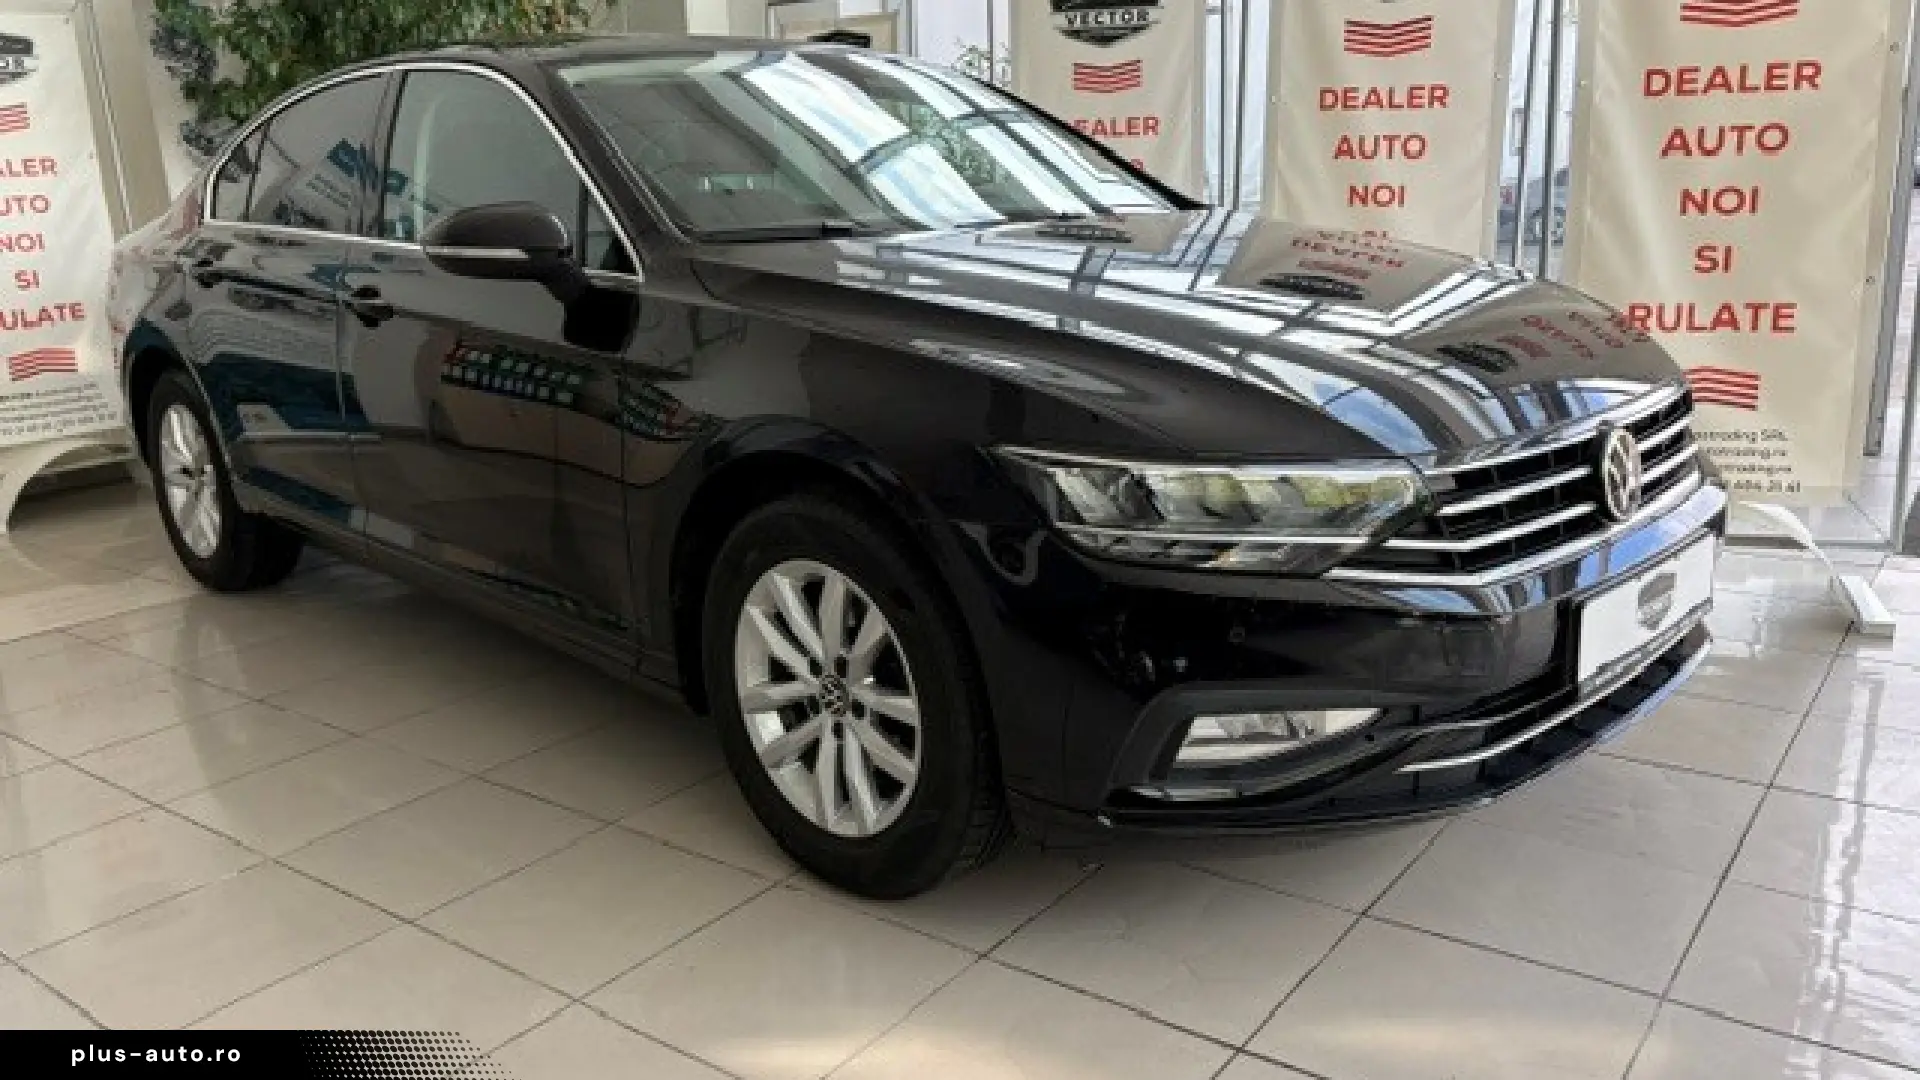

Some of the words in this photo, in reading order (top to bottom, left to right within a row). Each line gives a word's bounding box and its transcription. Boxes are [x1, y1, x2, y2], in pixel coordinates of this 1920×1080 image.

[1064, 8, 1150, 26] VECTOR
[1643, 60, 1823, 98] DEALER
[1319, 84, 1450, 111] DEALER
[1072, 117, 1160, 137] EALER
[1660, 123, 1789, 158] AUTO
[1333, 134, 1427, 160] AUTO
[1347, 183, 1406, 207] NOI
[1679, 186, 1759, 216] NOI
[1693, 245, 1732, 273] SI
[14, 269, 40, 290] SI
[1628, 302, 1798, 334] RULATE
